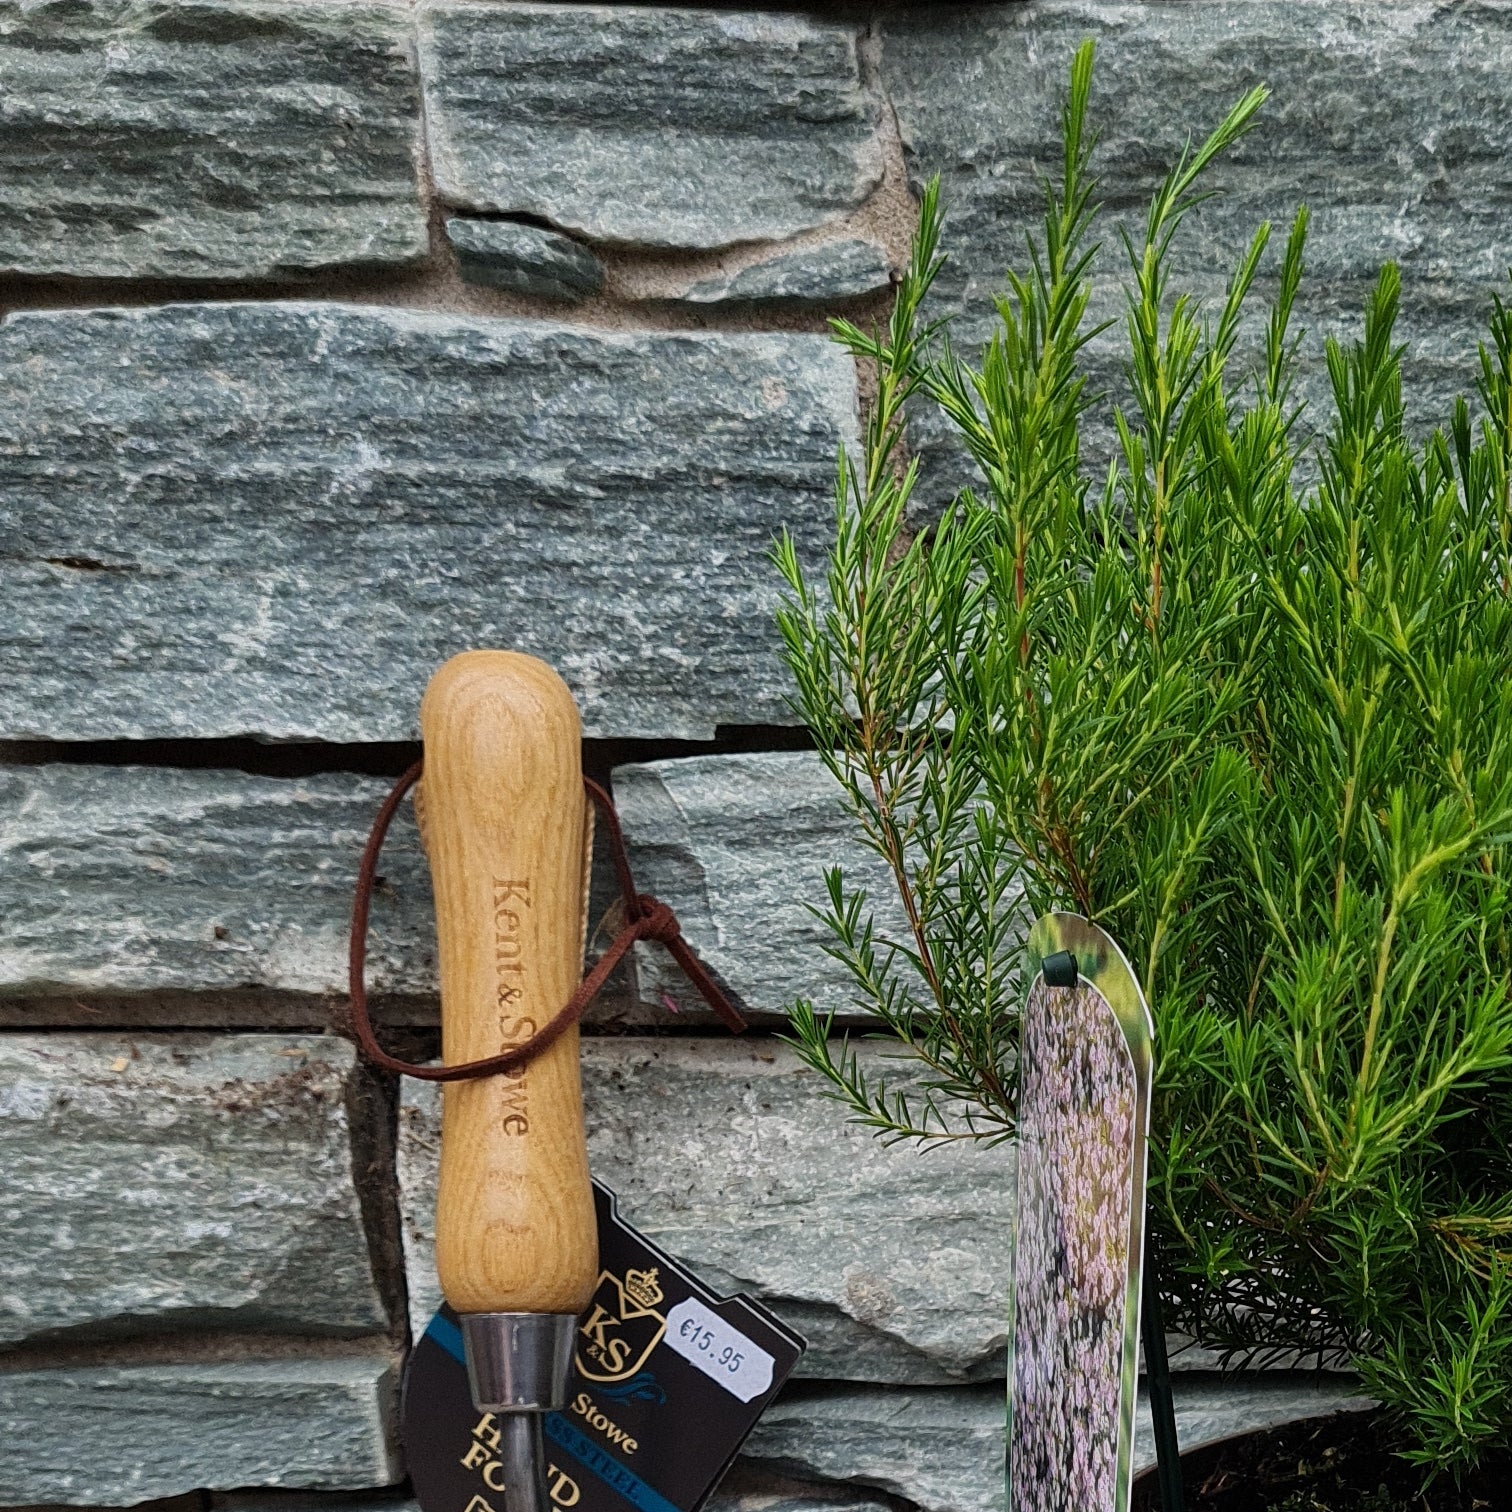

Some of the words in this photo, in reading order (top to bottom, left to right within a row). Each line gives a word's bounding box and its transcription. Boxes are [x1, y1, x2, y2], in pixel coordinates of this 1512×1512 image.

[492, 876, 531, 976] Kent
[497, 983, 523, 1005] &
[679, 1317, 746, 1373] €15.95
[569, 1391, 639, 1456] Stowe
